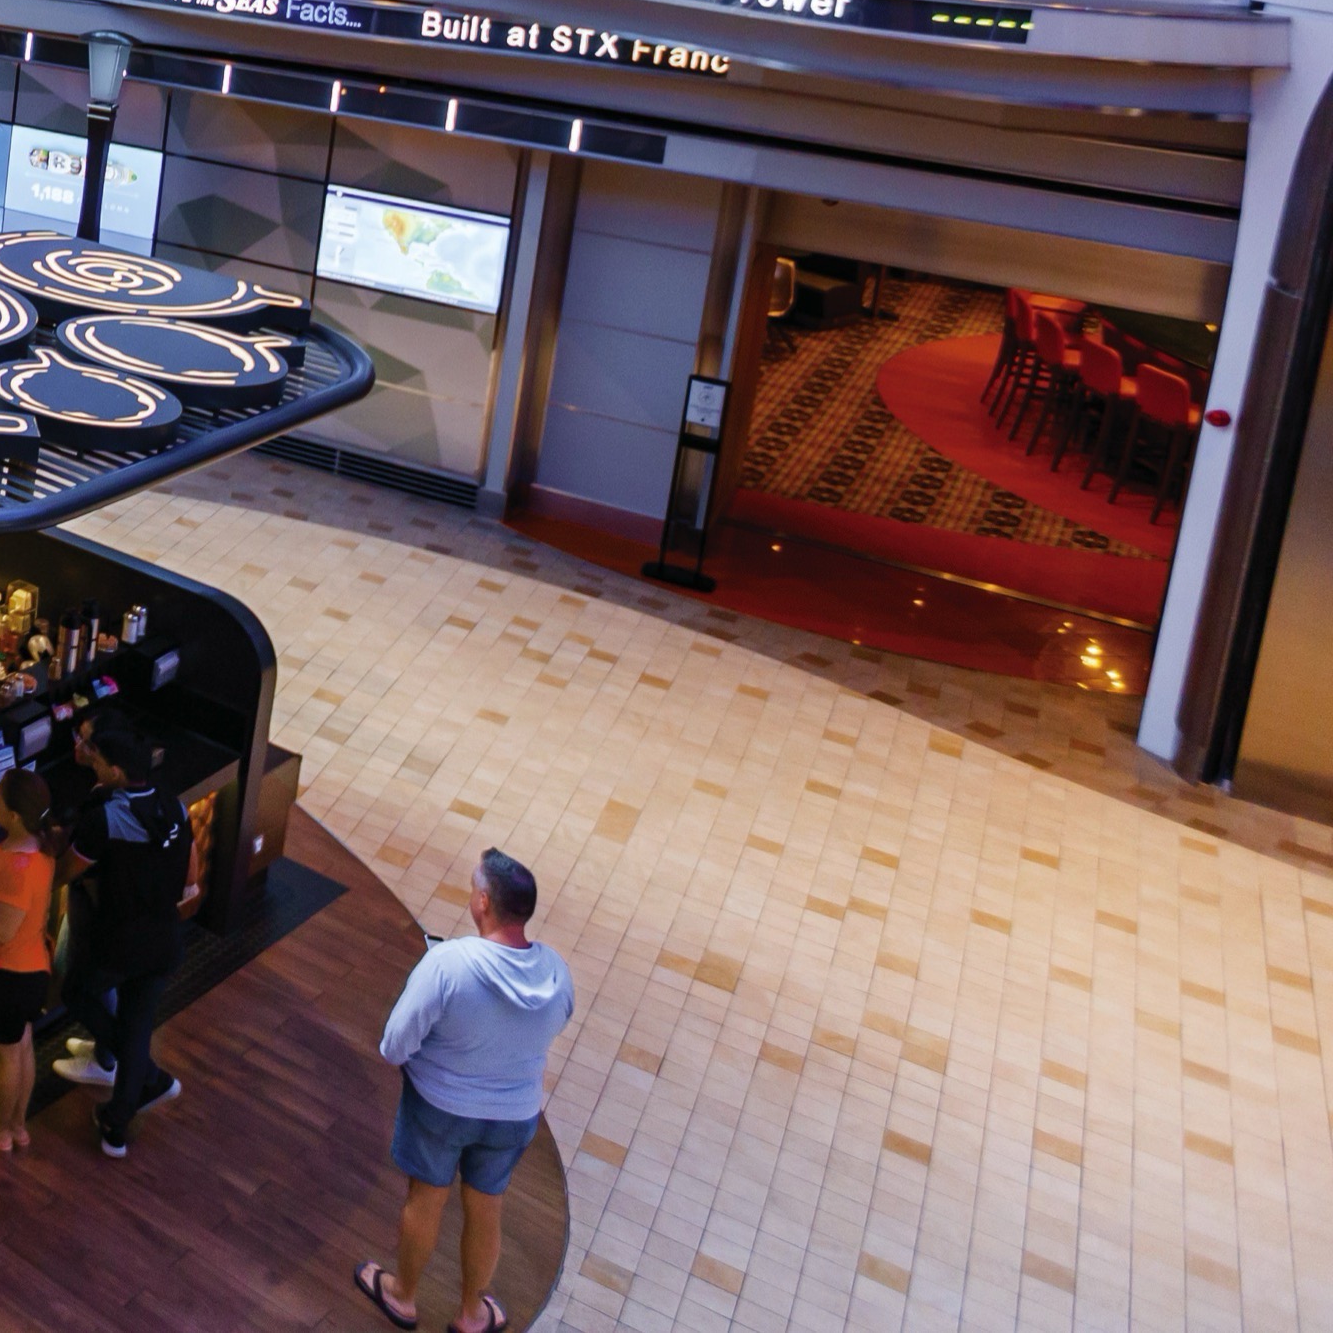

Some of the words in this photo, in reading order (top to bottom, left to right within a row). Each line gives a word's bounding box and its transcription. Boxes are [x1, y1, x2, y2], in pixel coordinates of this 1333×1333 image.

[420, 9, 492, 44] Built
[506, 22, 541, 49] at
[550, 24, 620, 60] STX
